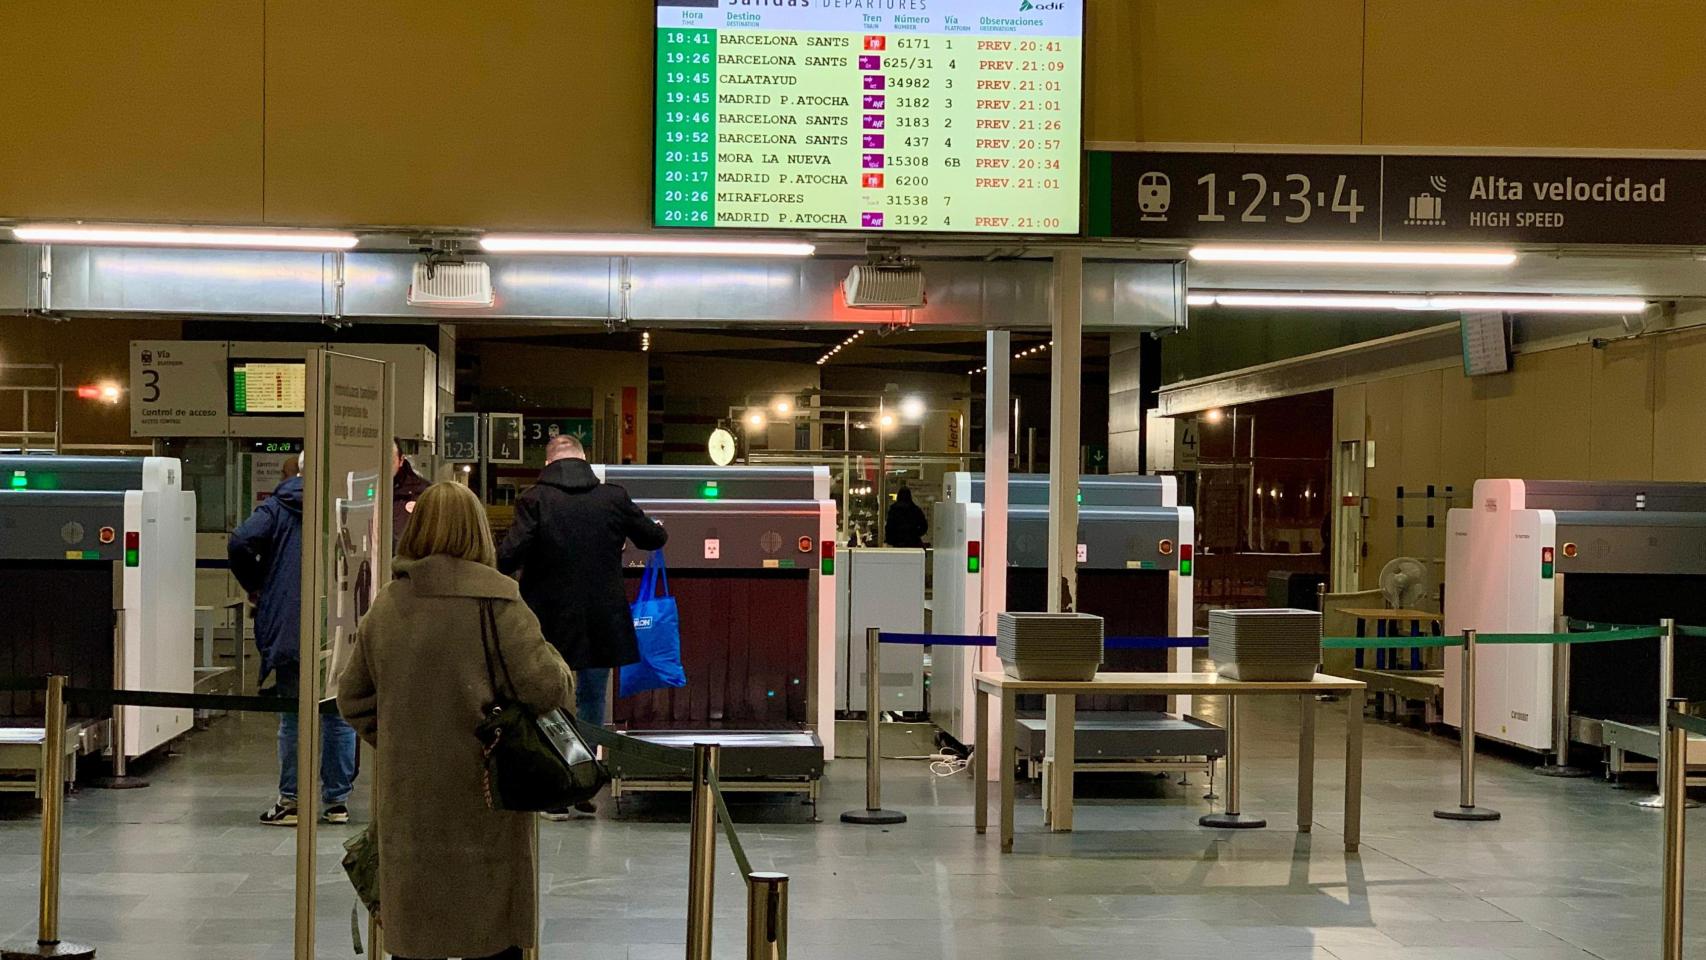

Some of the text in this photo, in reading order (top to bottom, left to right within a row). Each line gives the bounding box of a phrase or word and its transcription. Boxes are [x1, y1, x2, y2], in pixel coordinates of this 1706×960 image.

[823, 0, 927, 10] DEPARTURES
[1036, 3, 1065, 11] adif
[682, 10, 703, 19] Hora
[727, 12, 761, 21] Destino
[863, 14, 882, 22] Tren
[894, 15, 930, 23] Número
[945, 16, 958, 24] Vía
[980, 16, 1044, 27] Observaciones
[668, 33, 1061, 51] 18:41 BARCELONA SANTS 6171 1 PREV.20:41
[668, 53, 1064, 71] 19:26 BARCELONA SANTS 625/31 4 PREV.21:09
[668, 73, 1060, 91] 19:45 CALATAYUD 34982 3 PREV.21:01
[667, 93, 709, 103] 19:45
[719, 95, 770, 104] MADRID
[781, 96, 849, 106] P.ATOCHA
[897, 98, 929, 107] 3182
[945, 99, 952, 108] 3
[977, 100, 1060, 110] PREV.21:01
[667, 112, 709, 122] 19:46
[720, 114, 797, 124] BARCELONA
[806, 116, 848, 125] SANTS
[897, 117, 929, 127] 3183
[945, 119, 951, 127] 2
[977, 120, 1060, 130] PREV.21:26
[667, 132, 1060, 149] 19:52 BARCELONA SANTS 437 4 PREV.20:57
[666, 152, 708, 162] 20:15
[719, 154, 753, 162] MORA
[762, 154, 779, 163] LA
[788, 155, 831, 164] NUEVA
[888, 156, 928, 166] 15308
[945, 158, 960, 167] 6B
[976, 159, 1059, 169] PREV.20:34
[666, 171, 1059, 189] 20:17 MADRID P.ATOCHA 6200 PREV.21:01
[666, 191, 708, 201] 20:26
[718, 193, 803, 203] MIRAFLORES
[887, 196, 928, 205] 31538
[944, 197, 950, 205] 7
[1470, 176, 1666, 203] Alta velocidad
[665, 211, 708, 221] 20:26
[718, 213, 769, 222] MADRID
[779, 214, 847, 223] P.ATOCHA
[896, 215, 927, 225] 3192
[944, 216, 950, 225] 4
[976, 217, 1059, 227] PREV.21:00
[1470, 212, 1564, 229] HIGH SPEED
[142, 370, 160, 402] 3
[532, 423, 542, 440] 3
[1182, 428, 1196, 450] 4
[501, 443, 510, 458] 4
